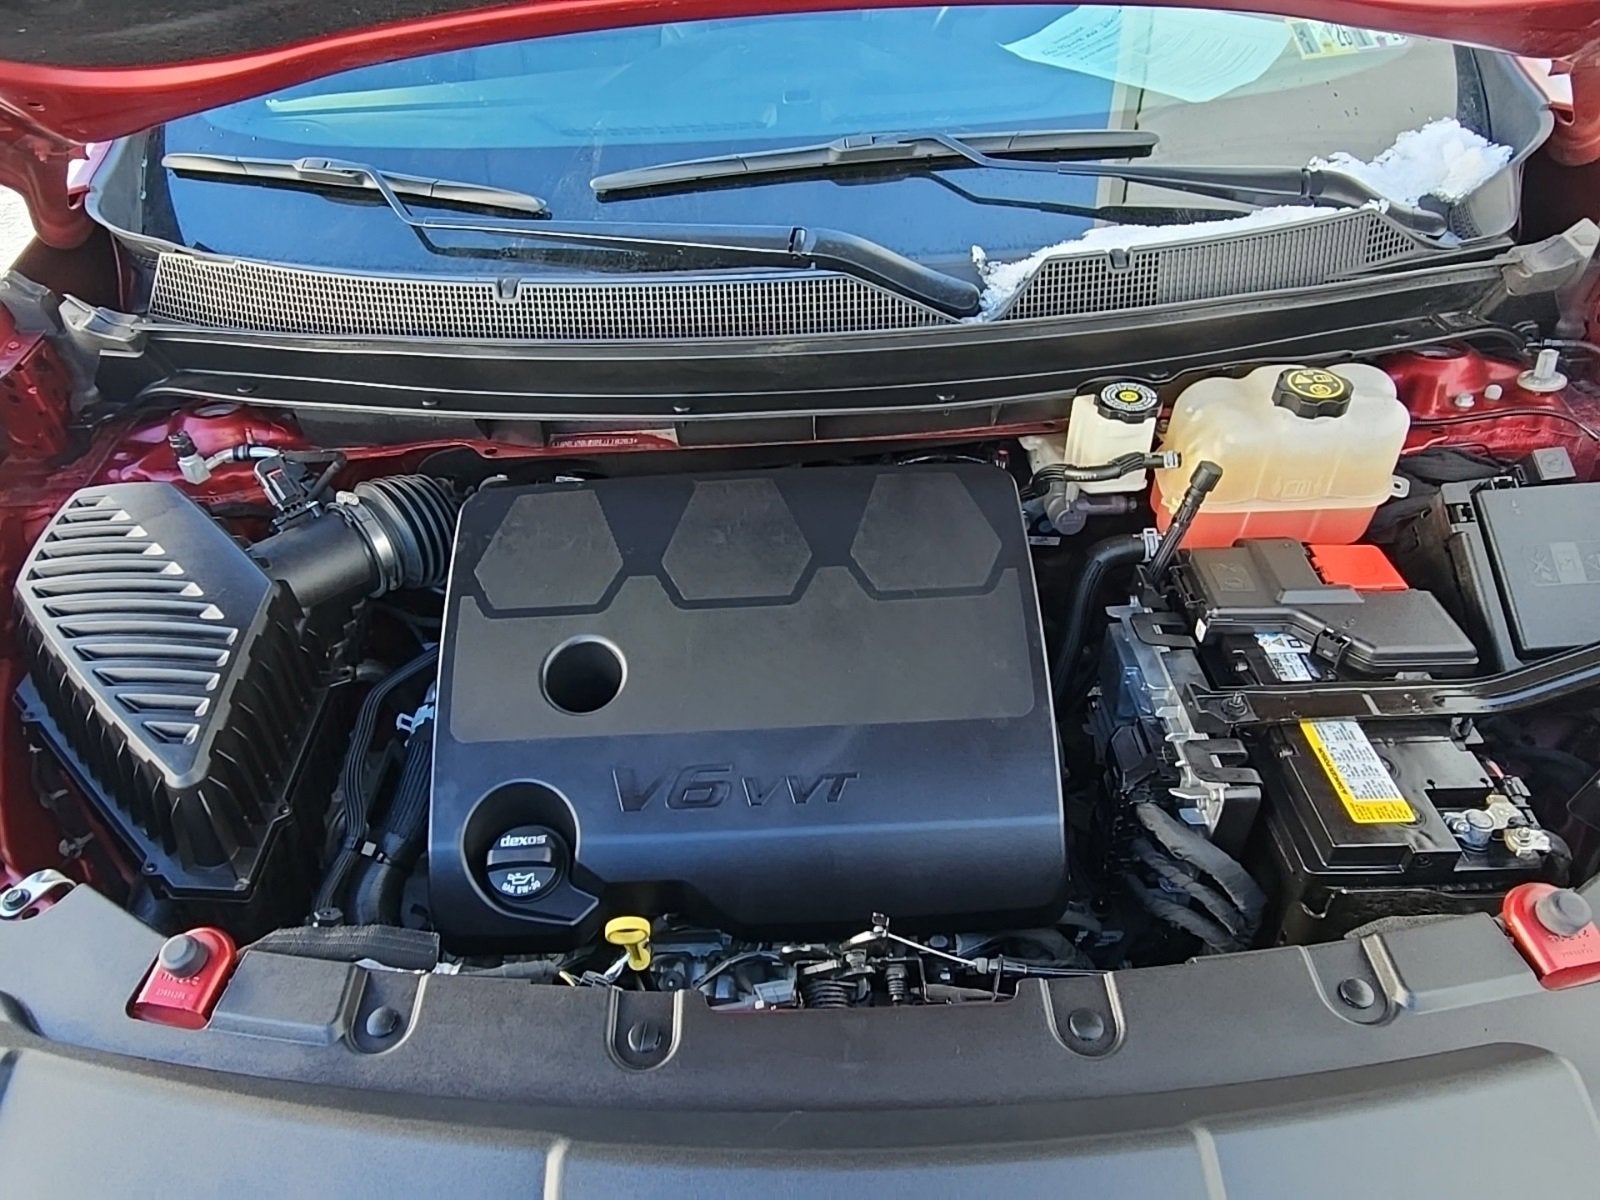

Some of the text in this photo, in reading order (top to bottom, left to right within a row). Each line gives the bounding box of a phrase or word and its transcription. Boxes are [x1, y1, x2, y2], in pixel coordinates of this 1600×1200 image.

[612, 764, 860, 812] V6 VVT
[500, 834, 548, 848] dexos
[501, 882, 514, 894] SAE
